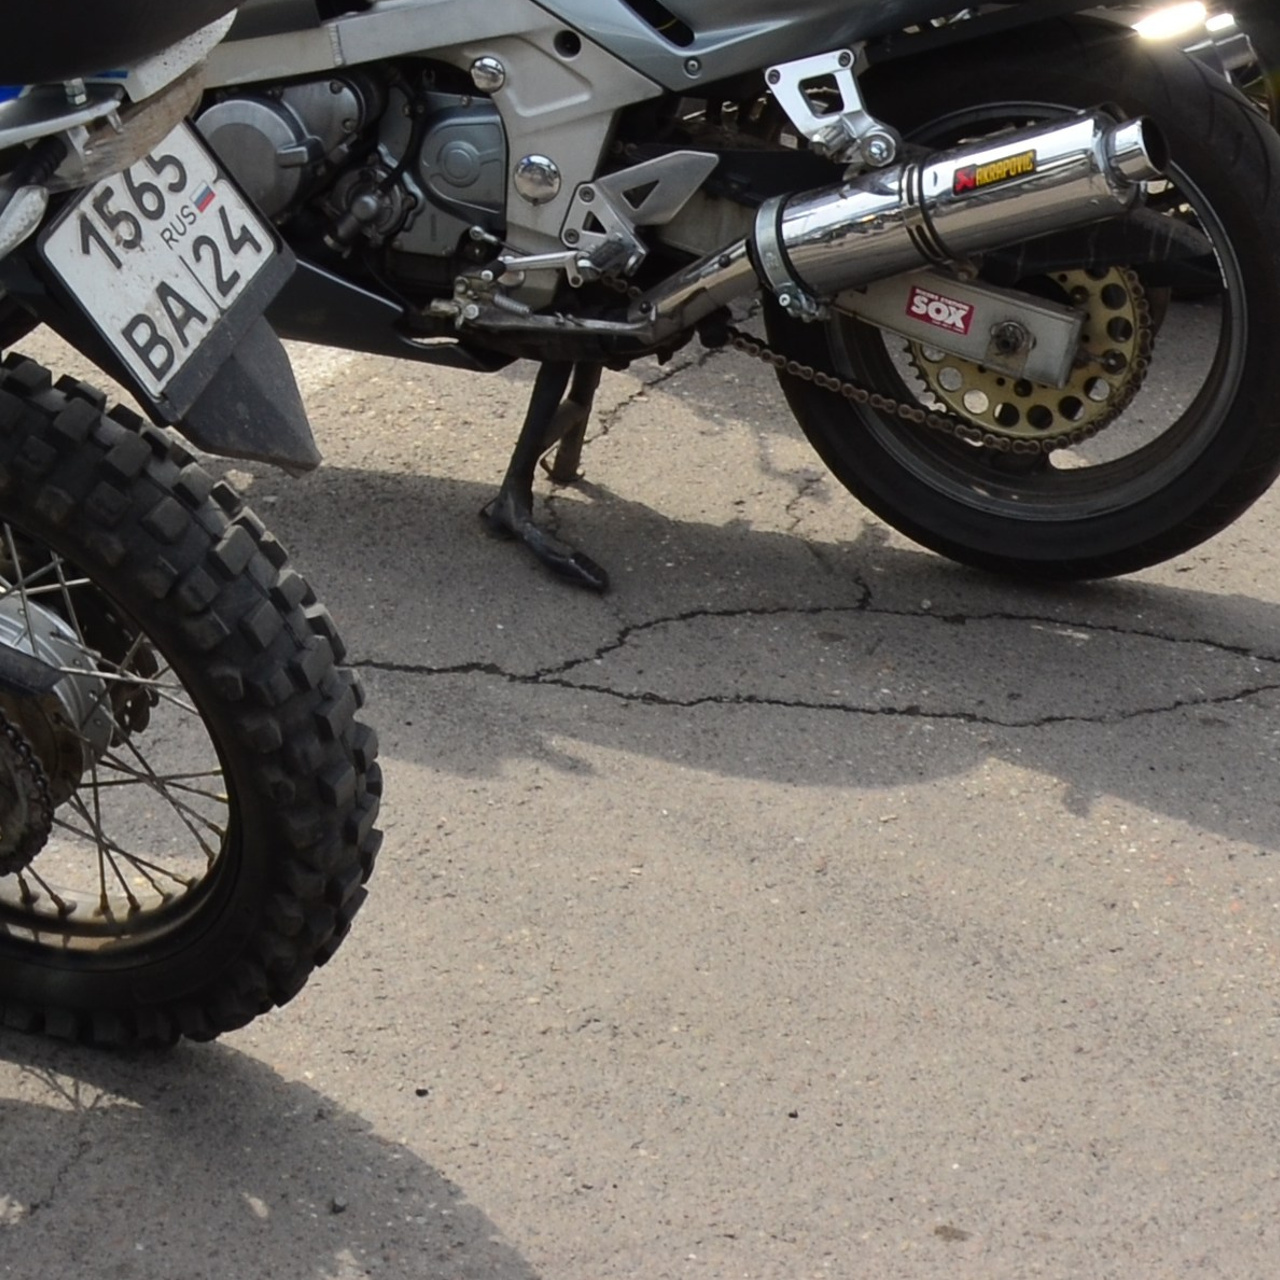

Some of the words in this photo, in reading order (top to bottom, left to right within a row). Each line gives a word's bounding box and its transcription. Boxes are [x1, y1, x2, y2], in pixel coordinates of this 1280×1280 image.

[78, 153, 188, 270] 1565
[160, 204, 197, 250] RUS
[192, 205, 263, 298] 24
[910, 294, 969, 330] SOX
